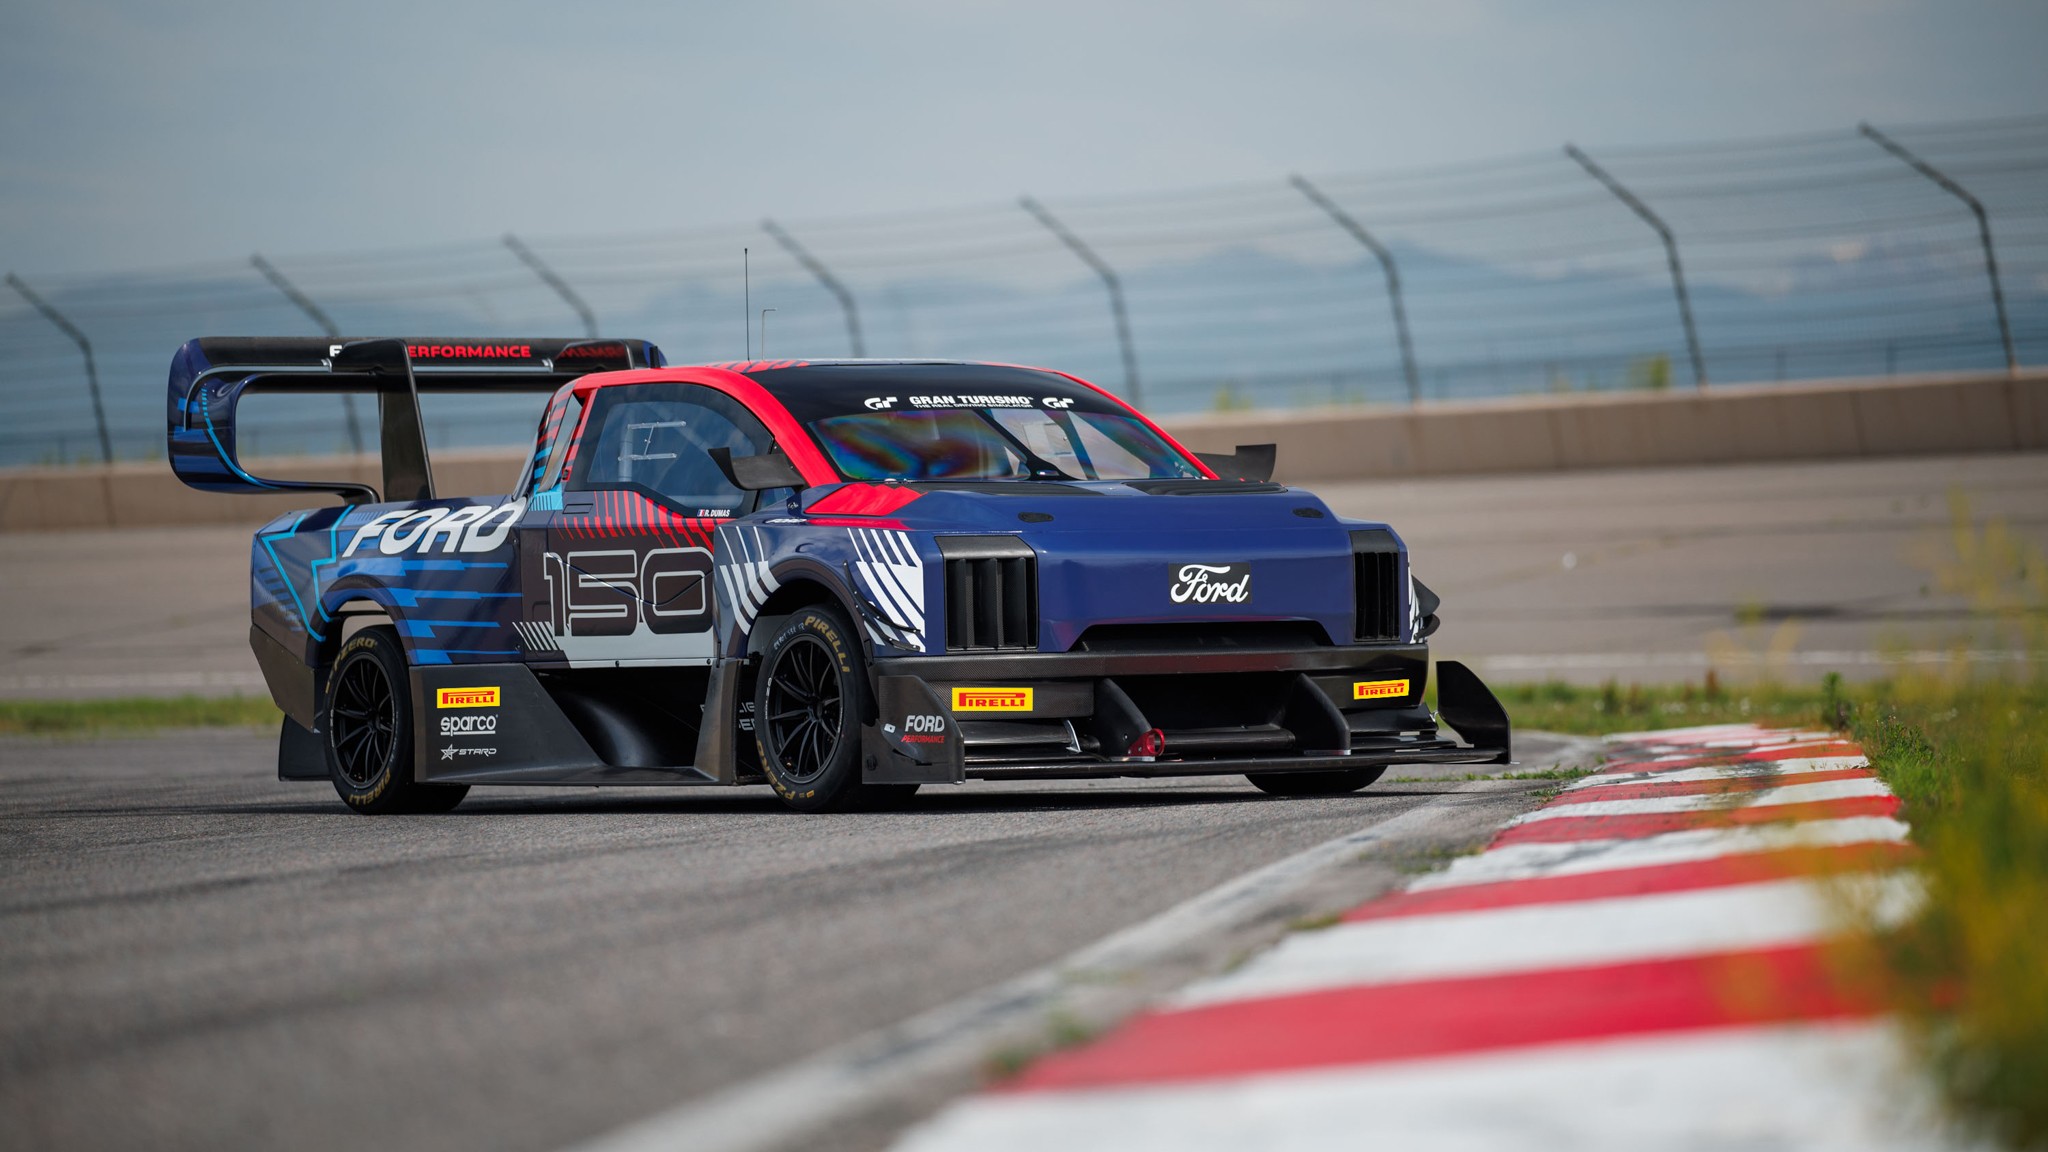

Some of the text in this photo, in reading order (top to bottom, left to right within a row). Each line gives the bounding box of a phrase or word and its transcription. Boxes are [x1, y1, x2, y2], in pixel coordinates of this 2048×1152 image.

[407, 345, 531, 357] ERFORMANCE
[909, 395, 1031, 405] GRAN TURISMO
[710, 509, 731, 517] DUMAS
[342, 497, 527, 558] FORD
[1170, 564, 1250, 603] Ford
[543, 546, 714, 638] 150
[804, 615, 851, 673] PIRELLI
[442, 690, 495, 705] PIRELLI
[1358, 682, 1405, 697] PIRELLI
[959, 692, 1026, 707] PIRELLI
[440, 714, 498, 737] sparco
[905, 715, 945, 732] FORD
[901, 735, 945, 744] PERFORMANCE
[348, 767, 391, 805] PIRELLI
